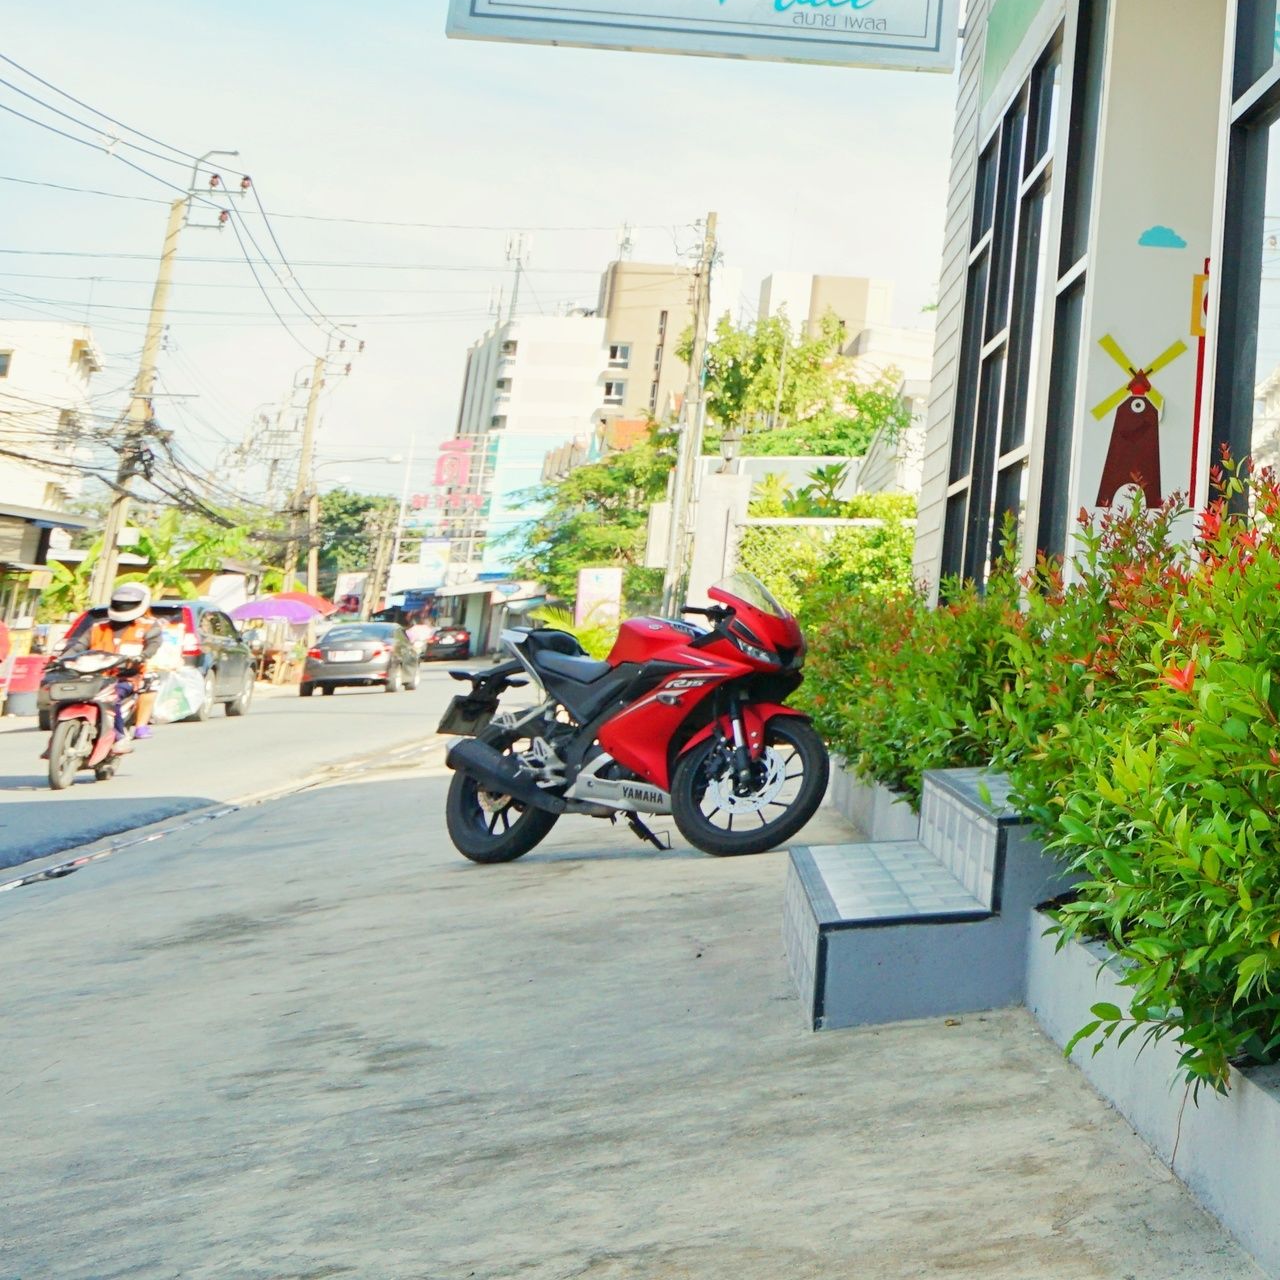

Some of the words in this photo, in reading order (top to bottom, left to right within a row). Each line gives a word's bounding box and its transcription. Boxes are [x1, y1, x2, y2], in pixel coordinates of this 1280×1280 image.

[792, 11, 836, 28] สบาย
[844, 15, 887, 31] เพลส
[622, 785, 664, 804] YAMAHA
